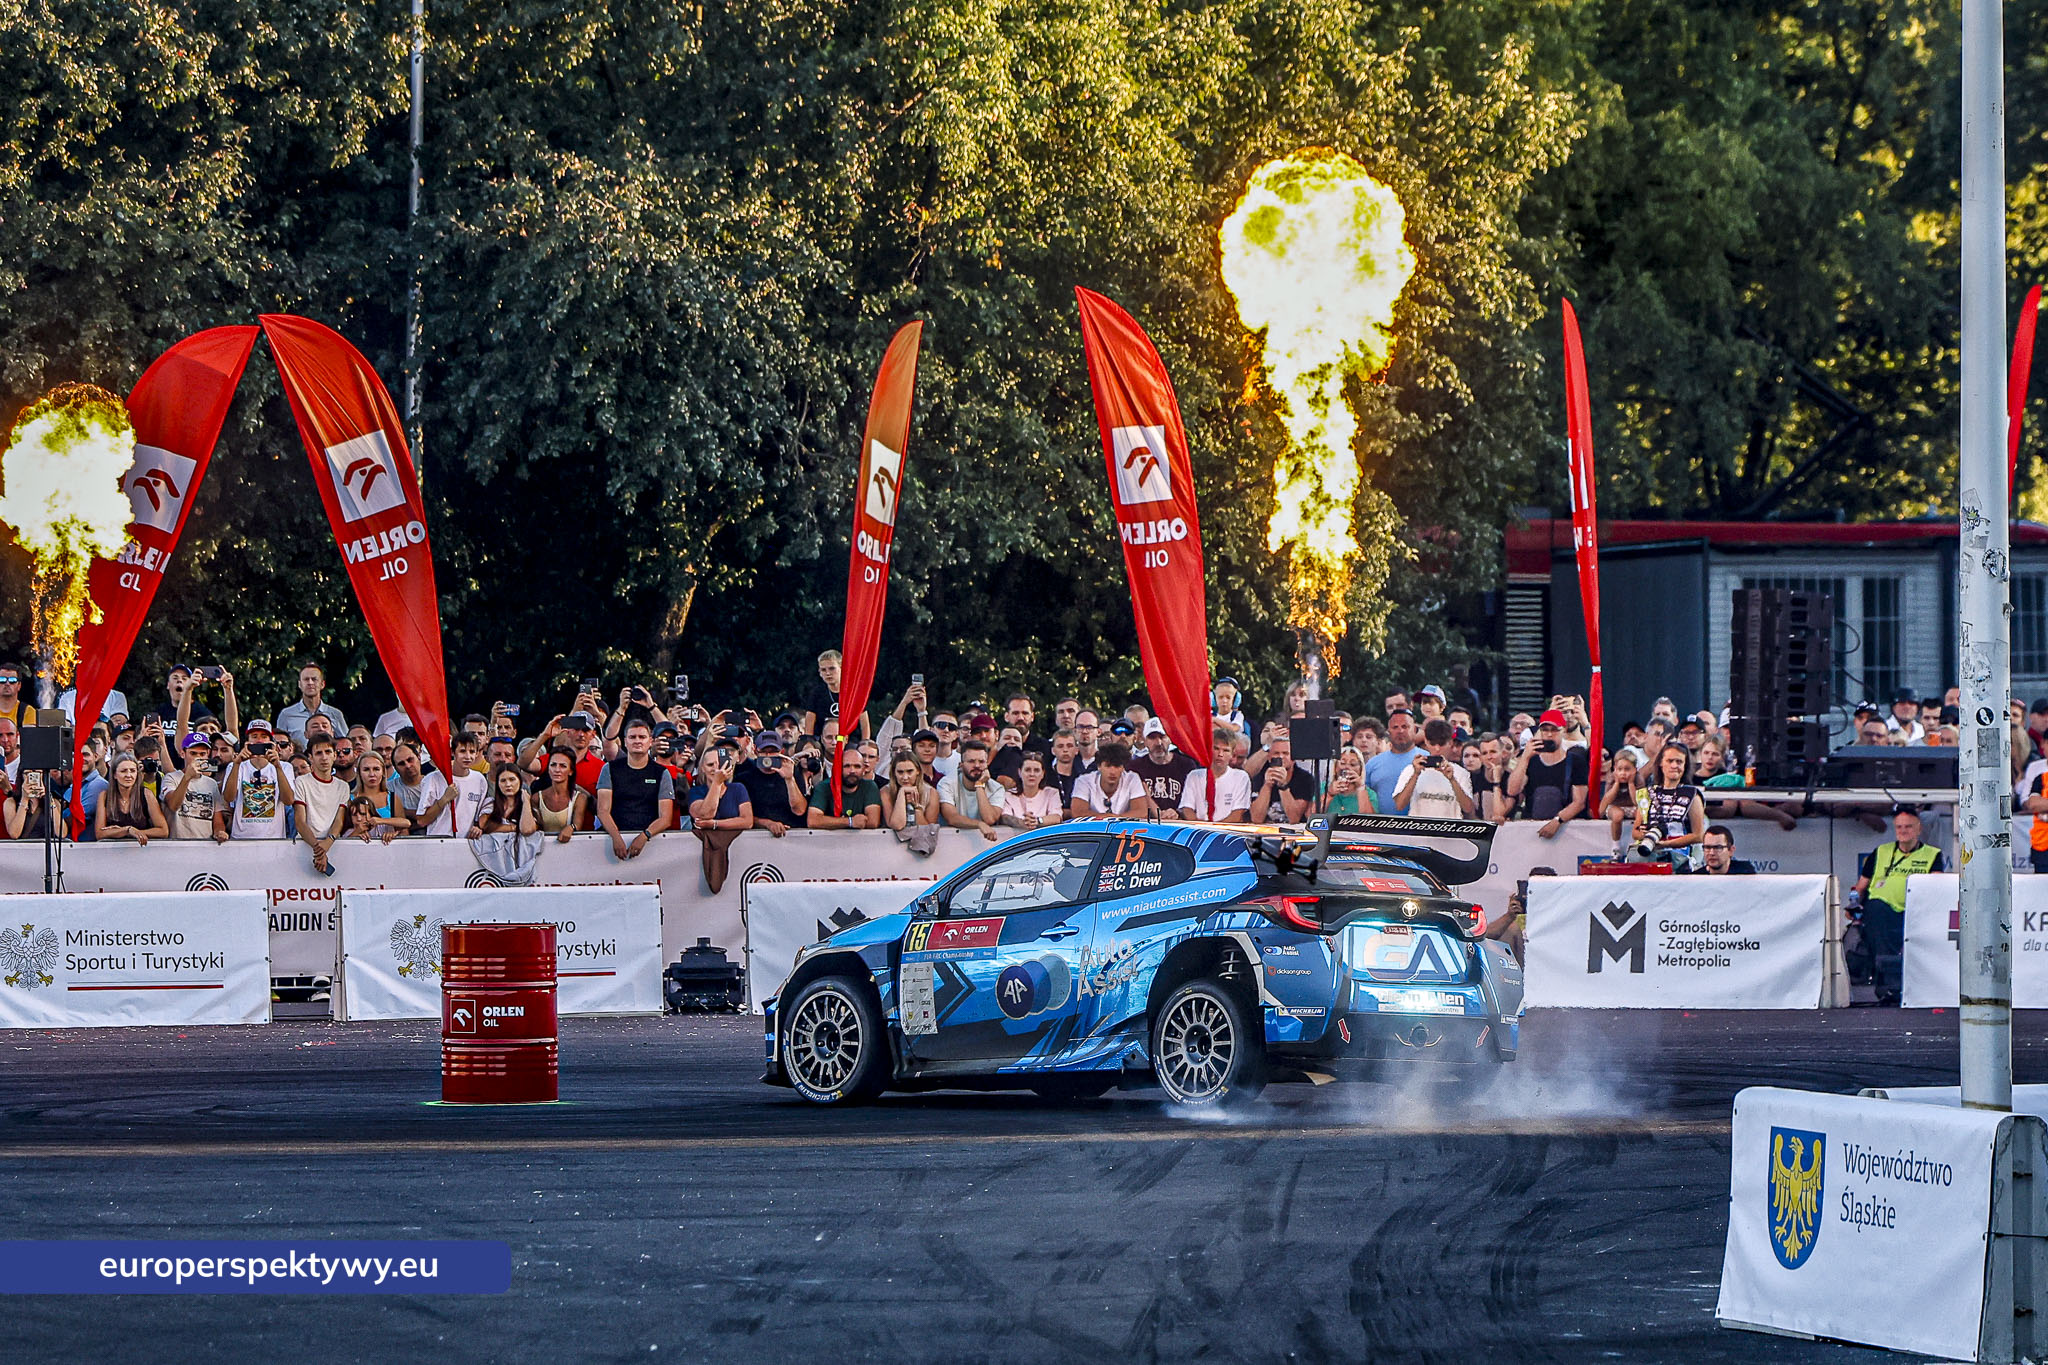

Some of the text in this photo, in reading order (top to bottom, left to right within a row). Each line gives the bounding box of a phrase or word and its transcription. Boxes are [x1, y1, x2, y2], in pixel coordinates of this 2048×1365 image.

[1338, 817, 1487, 834] www.niautoassist.com
[1115, 829, 1148, 863] 15
[1116, 861, 1162, 877] P. Allen
[1114, 876, 1162, 890] C. Drew
[1101, 887, 1227, 920] www.niautoassist.com
[269, 913, 322, 932] ADION
[964, 926, 988, 934] ORLEN
[1659, 919, 1741, 936] Górnośląsko
[65, 929, 185, 947] Ministerstwo
[909, 923, 930, 951] 15
[557, 938, 616, 959] rystyki
[65, 952, 224, 973] Sportu i Turystyki
[1657, 954, 1731, 970] Metropolia
[482, 1006, 525, 1017] ORLEN
[482, 1018, 500, 1027] OIL
[1843, 1143, 1952, 1187] Województwo
[1840, 1185, 1896, 1233] Śląskie
